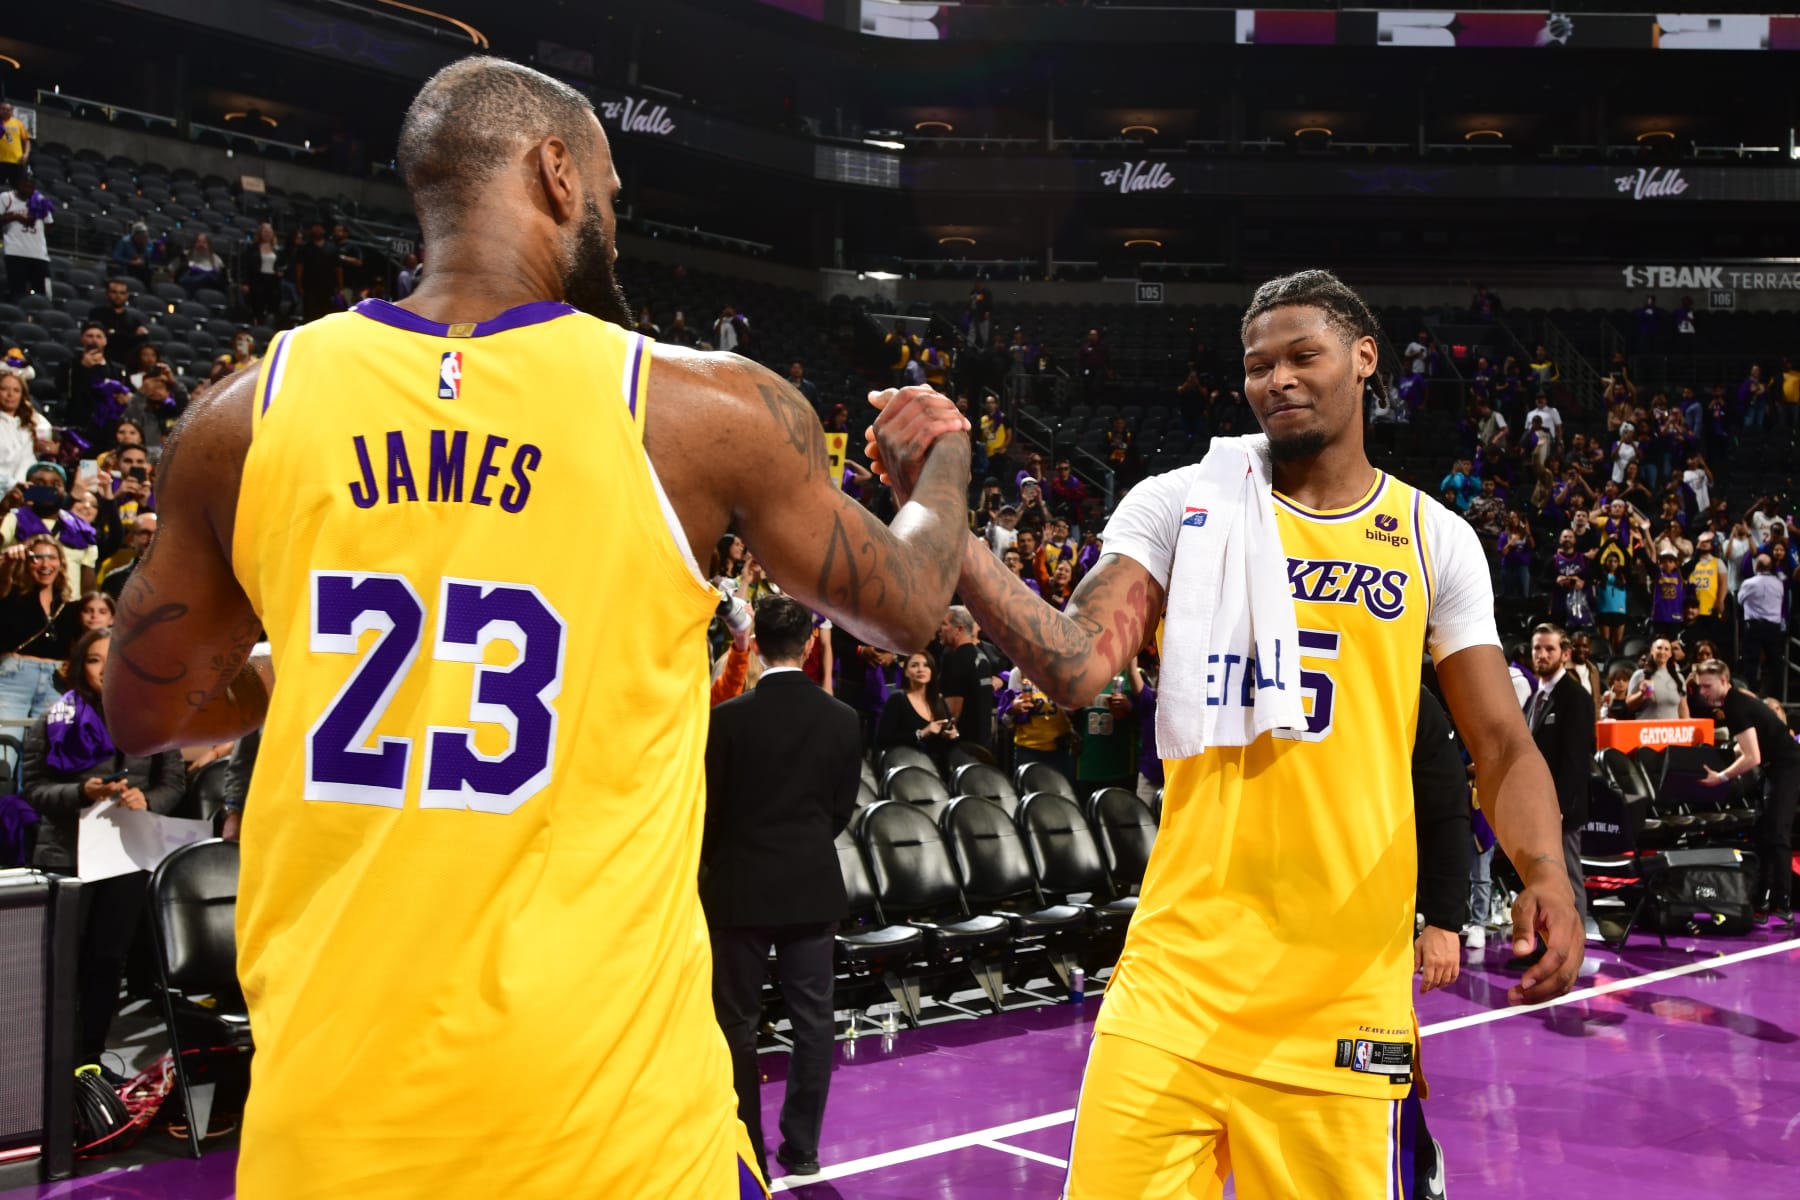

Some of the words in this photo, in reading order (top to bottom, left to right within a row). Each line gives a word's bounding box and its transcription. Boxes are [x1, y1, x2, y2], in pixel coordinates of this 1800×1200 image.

[621, 95, 676, 135] Valle
[1120, 159, 1175, 194] Valle
[1634, 166, 1688, 200] Valle
[1140, 286, 1159, 299] 105
[1713, 293, 1731, 306] 106
[348, 429, 542, 514] JAMES
[1365, 528, 1409, 547] bibigo
[1286, 557, 1411, 622] KERS
[303, 569, 568, 815] 23
